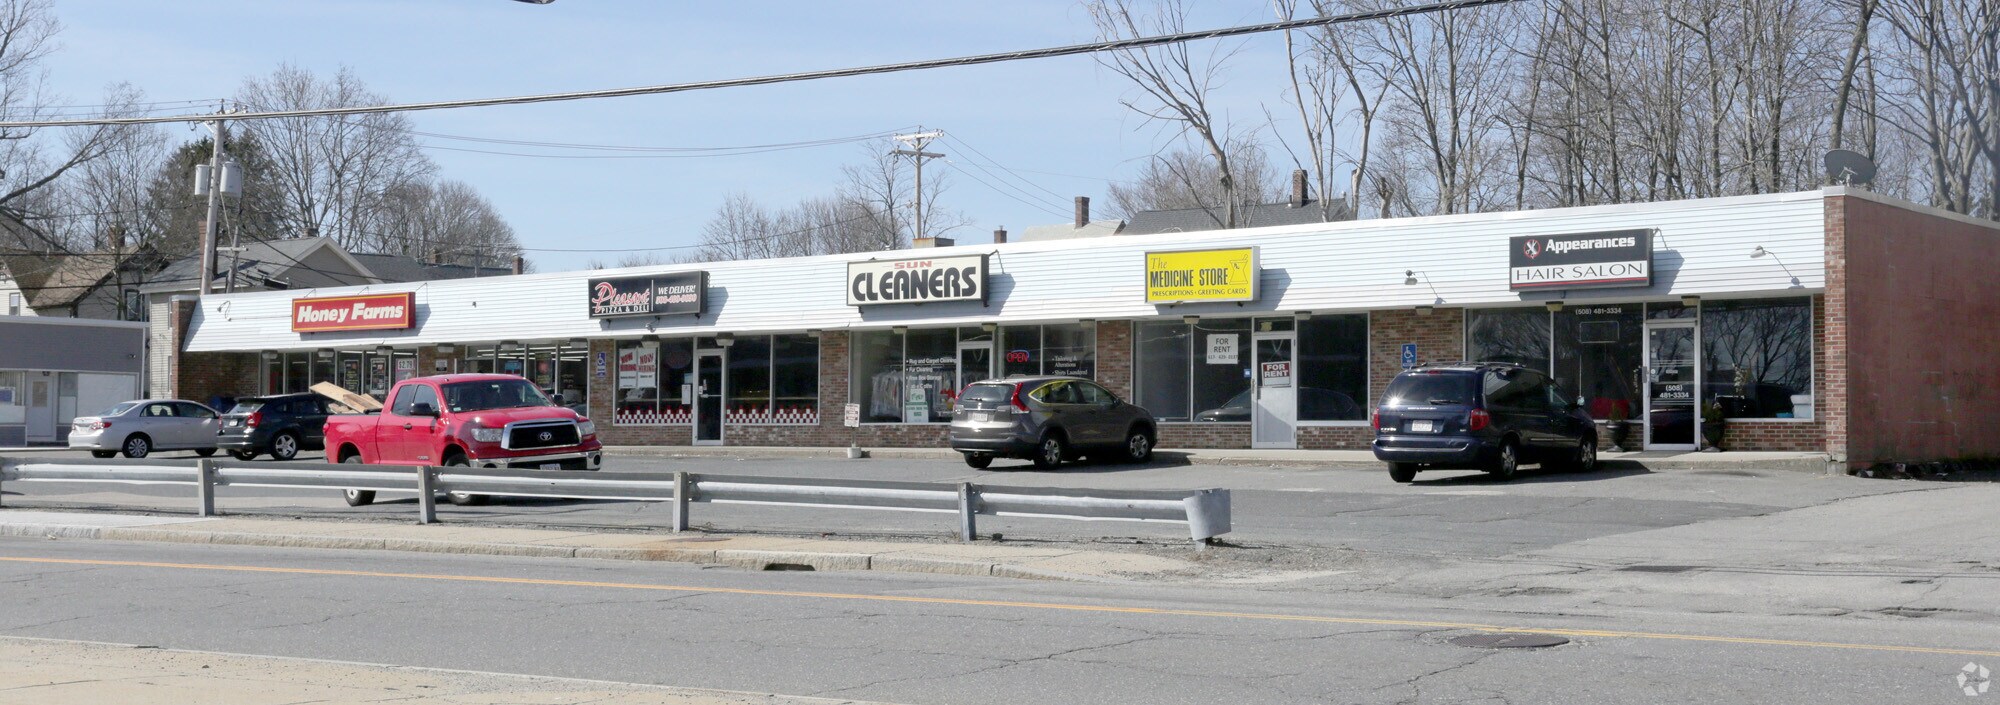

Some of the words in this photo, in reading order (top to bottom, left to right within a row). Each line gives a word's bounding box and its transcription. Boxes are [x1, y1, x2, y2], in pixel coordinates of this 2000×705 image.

[1545, 236, 1636, 254] Appearances
[894, 260, 932, 270] SUN
[1151, 257, 1168, 270] The
[1150, 269, 1195, 288] MEDICINE
[1199, 267, 1229, 286] STORE
[1516, 267, 1565, 281] HAIR
[1572, 263, 1643, 279] SALON
[852, 266, 977, 301] CLEANERS
[657, 286, 669, 295] WE
[668, 285, 697, 294] DELIVER!
[1197, 288, 1226, 296] GREETING
[1227, 287, 1247, 295] CARDS
[591, 281, 650, 313] Pleasant
[297, 305, 349, 323] Honey
[351, 302, 404, 320] Farms
[601, 306, 622, 314] PIZZA
[633, 304, 650, 312] DELI
[1215, 337, 1229, 345] FOR
[1213, 345, 1231, 353] RENT
[639, 353, 654, 364] NOW
[1006, 352, 1028, 363] OPEN
[1267, 363, 1285, 371] FOR
[1264, 370, 1288, 378] RENT
